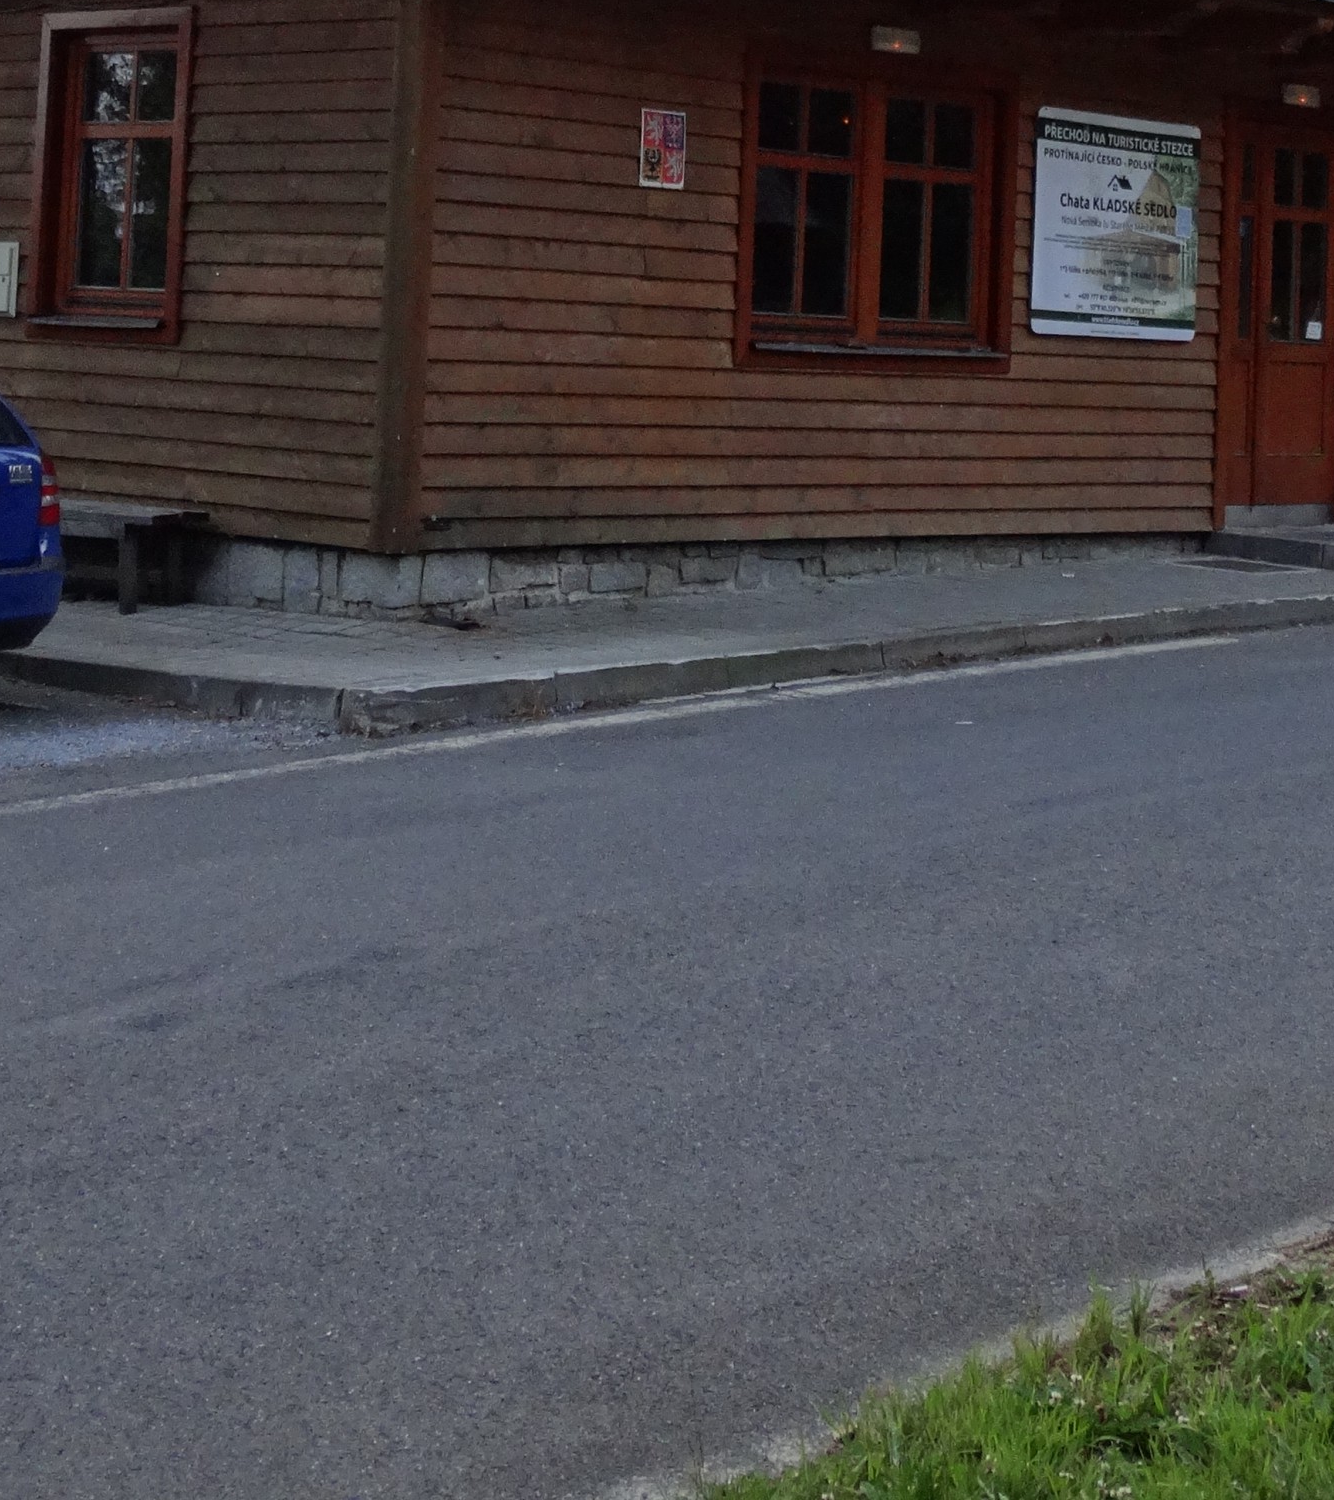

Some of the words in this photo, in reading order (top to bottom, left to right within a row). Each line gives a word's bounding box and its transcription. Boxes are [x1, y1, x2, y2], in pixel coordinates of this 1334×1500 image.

[1044, 122, 1090, 143] PŘECHOD
[1092, 132, 1106, 146] NA
[1108, 133, 1160, 153] TURISTICKÉ
[1161, 143, 1194, 157] STEZCE
[1044, 147, 1095, 164] PROTÍNAJÍCÍ
[1096, 152, 1122, 167] ČESKO
[1060, 192, 1090, 210] Chata
[1092, 196, 1142, 216] KLADSKÉ
[1144, 202, 1177, 219] SEDLO
